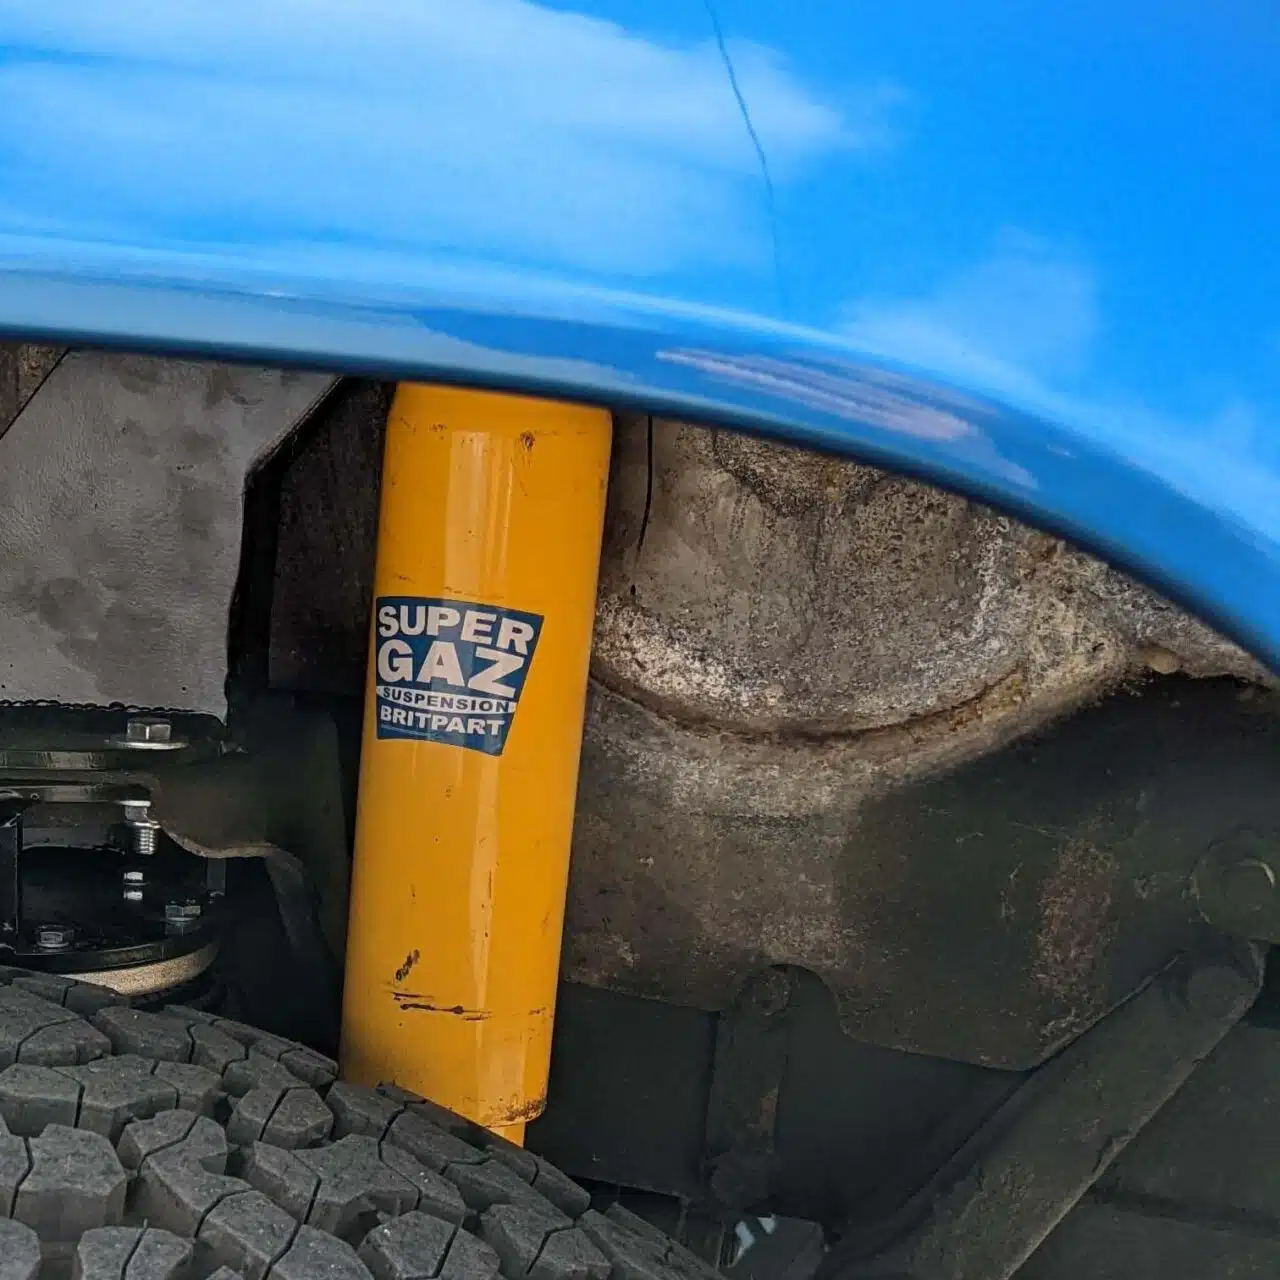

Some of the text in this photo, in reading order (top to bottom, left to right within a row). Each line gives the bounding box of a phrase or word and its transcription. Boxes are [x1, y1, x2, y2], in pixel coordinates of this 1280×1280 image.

[378, 605, 534, 655] SUPER
[377, 639, 524, 698] GAZ
[383, 686, 509, 713] SUSPENSION
[380, 705, 505, 736] BRITPART
